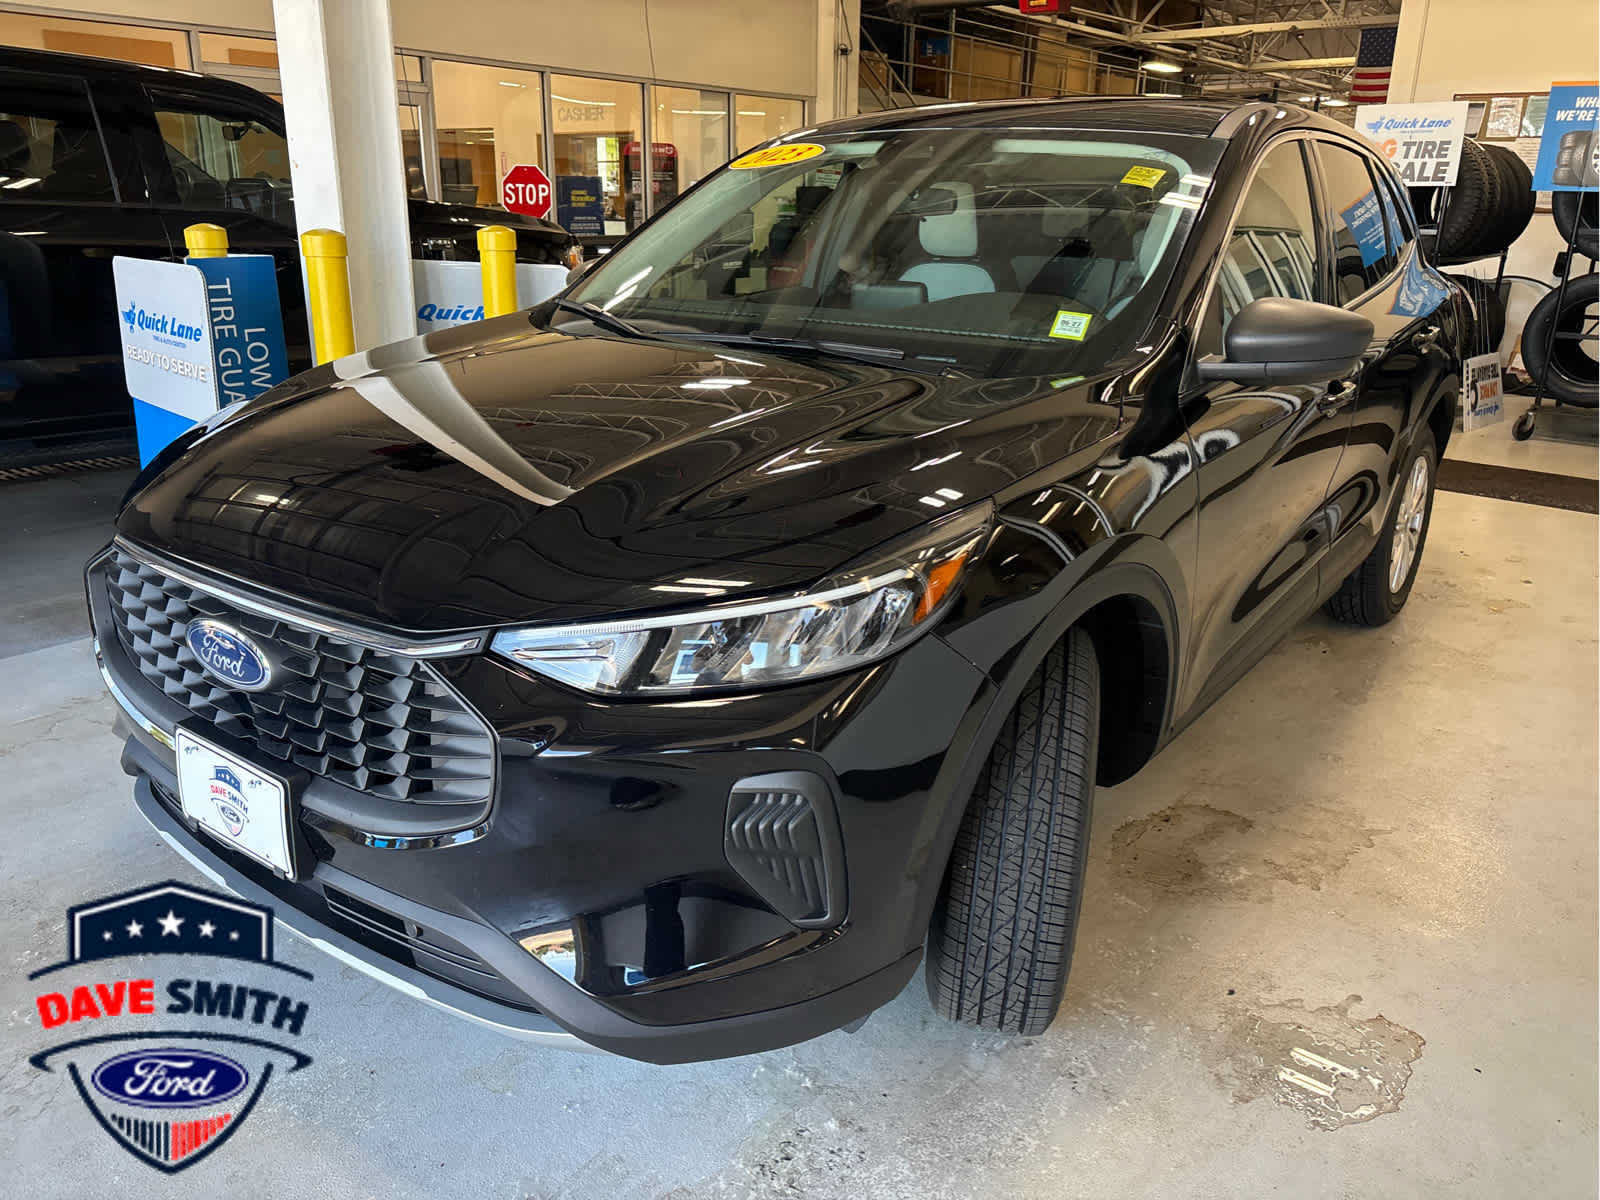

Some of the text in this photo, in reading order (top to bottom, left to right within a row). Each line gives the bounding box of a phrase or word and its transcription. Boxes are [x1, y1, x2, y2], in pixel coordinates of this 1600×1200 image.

[558, 107, 605, 122] CASHIER
[1384, 117, 1452, 130] Quick Lane
[1556, 110, 1596, 121] WE'RE
[1402, 140, 1452, 159] TIRE
[505, 183, 550, 206] STOP
[208, 277, 238, 340] TIRE
[418, 303, 485, 321] Quick
[138, 308, 169, 335] Quick
[169, 317, 202, 342] Lane
[126, 344, 208, 383] READY TO SERVE
[244, 327, 273, 388] LOW
[200, 633, 246, 678] Ford
[210, 784, 228, 798] DAVE
